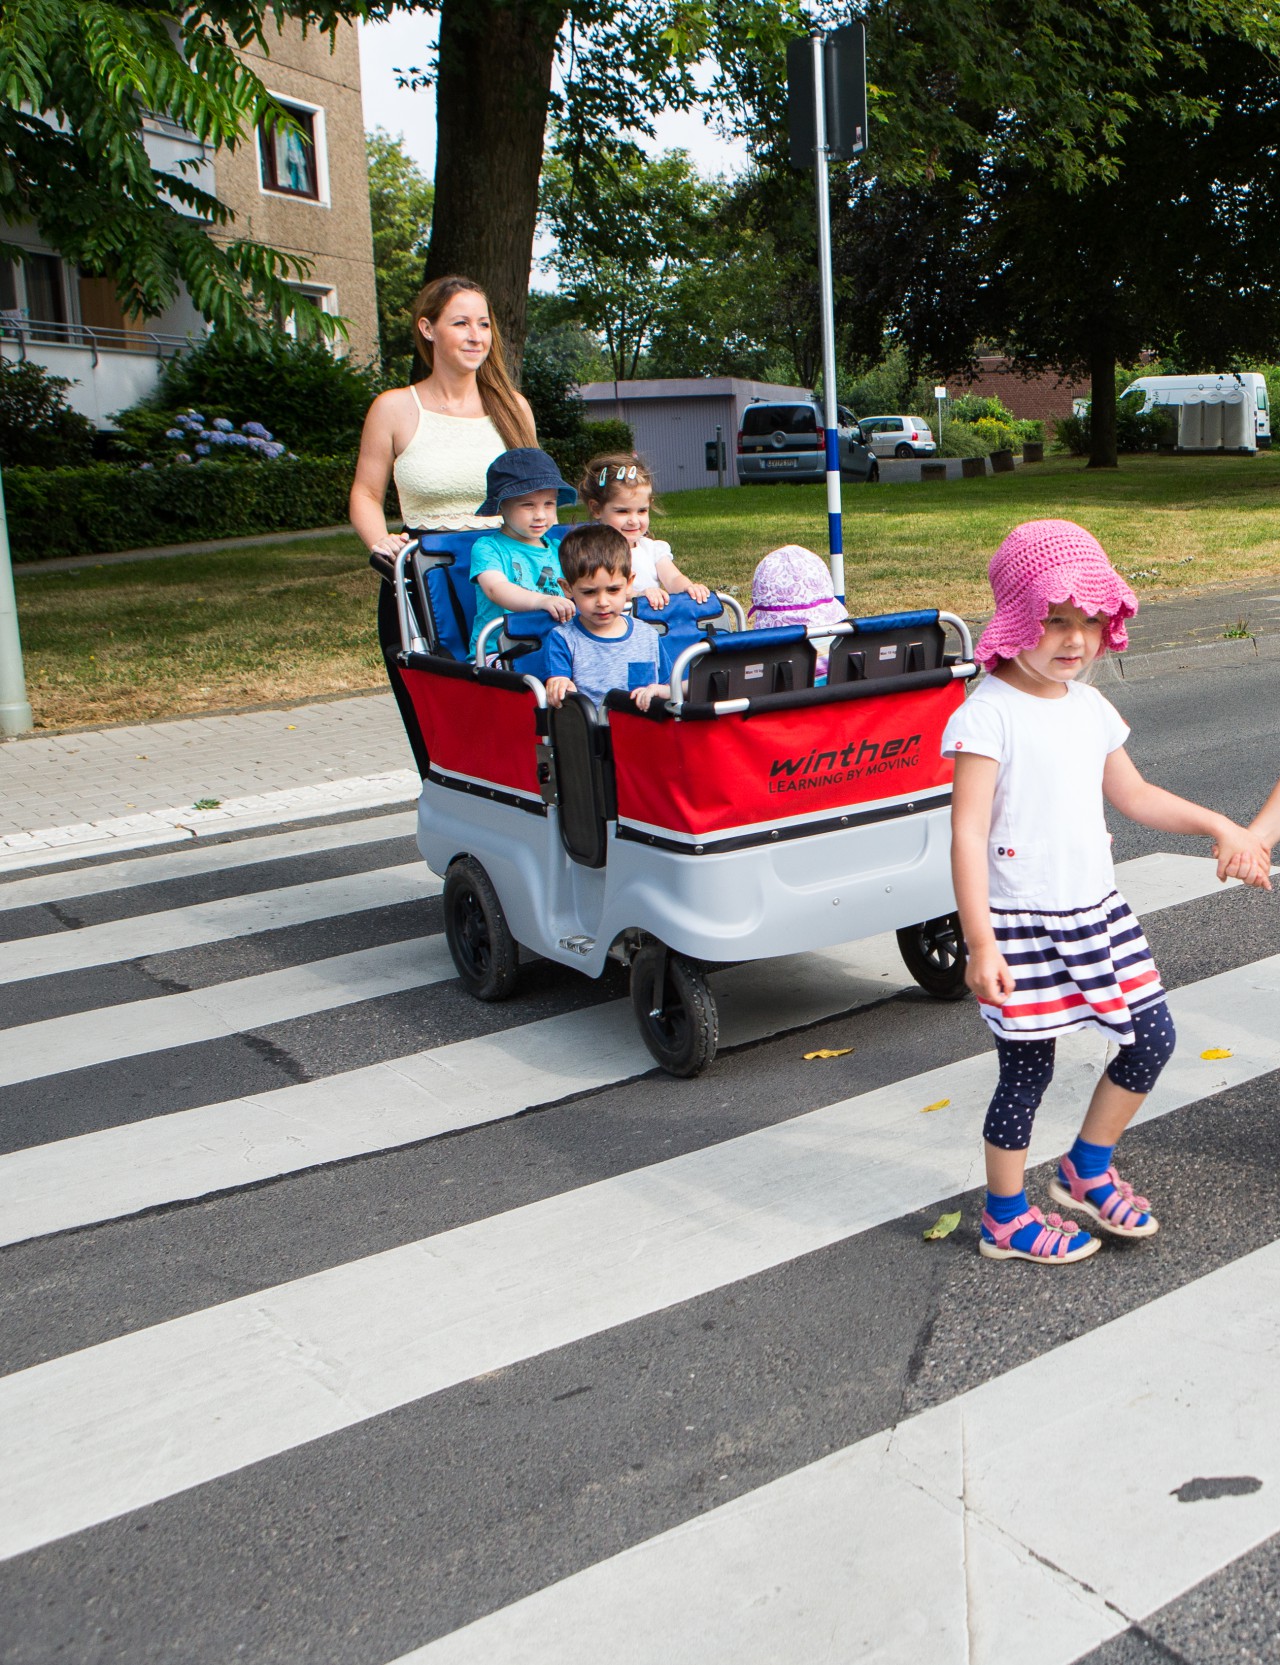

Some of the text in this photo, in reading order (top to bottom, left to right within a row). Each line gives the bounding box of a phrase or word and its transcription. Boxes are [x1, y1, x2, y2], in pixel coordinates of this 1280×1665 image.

[769, 735, 921, 777] winther
[769, 755, 919, 793] LEARNING BY MOVING
